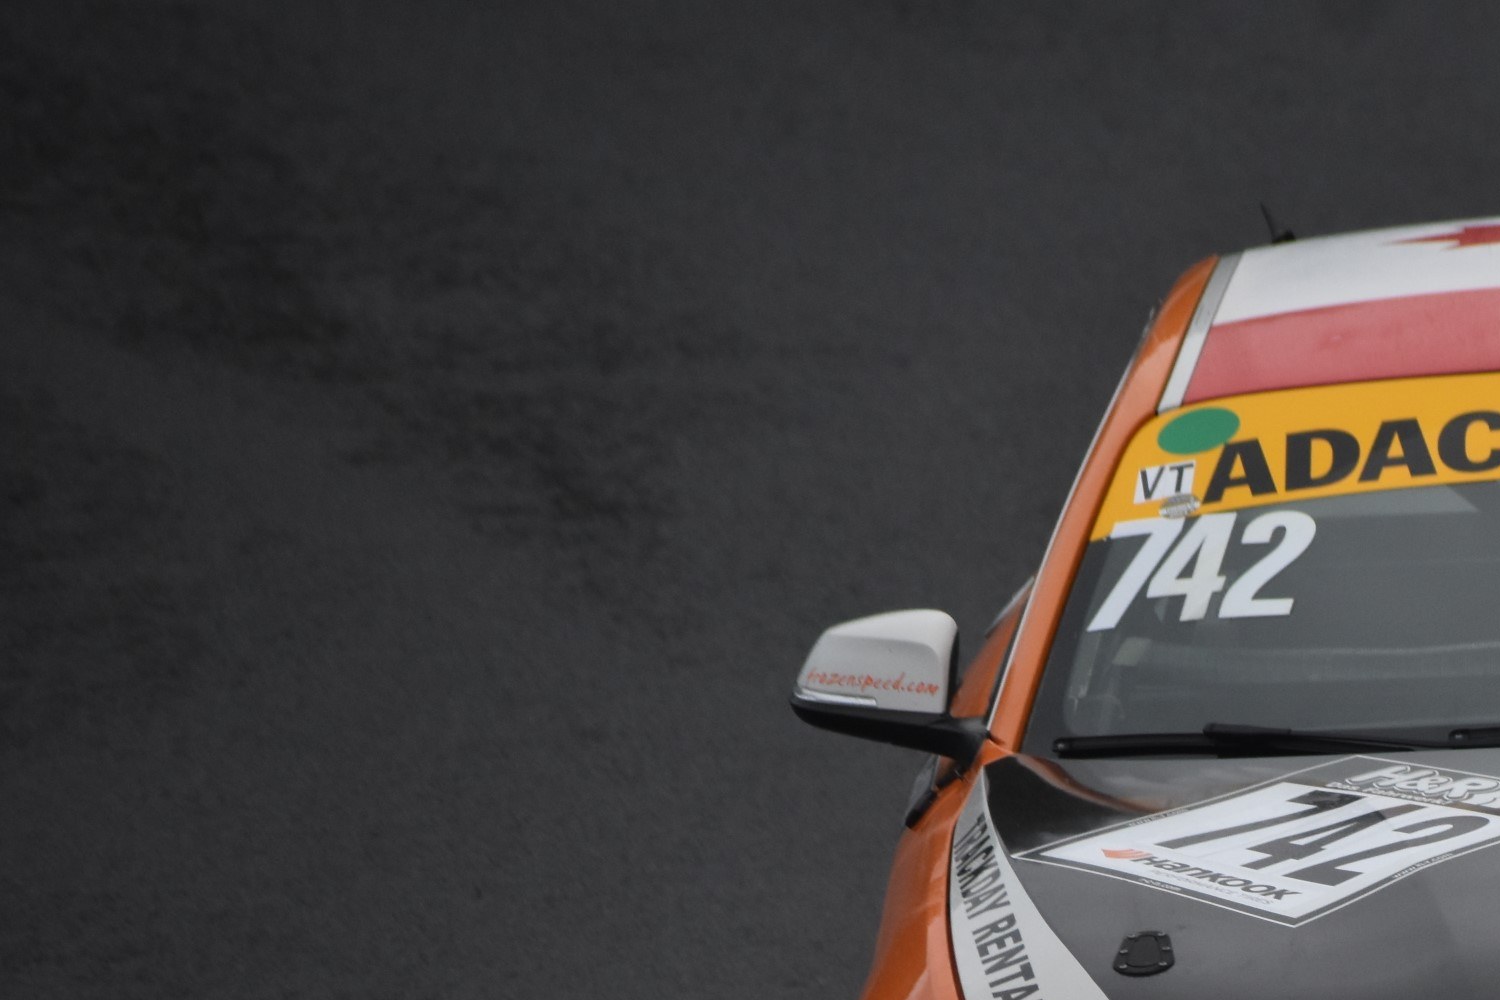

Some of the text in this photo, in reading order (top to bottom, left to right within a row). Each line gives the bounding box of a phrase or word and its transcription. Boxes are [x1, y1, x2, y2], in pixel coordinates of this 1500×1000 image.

[1140, 462, 1194, 500] VT
[1086, 510, 1317, 632] 742
[953, 811, 1011, 920] TRACKDAY
[1153, 789, 1490, 887] 742
